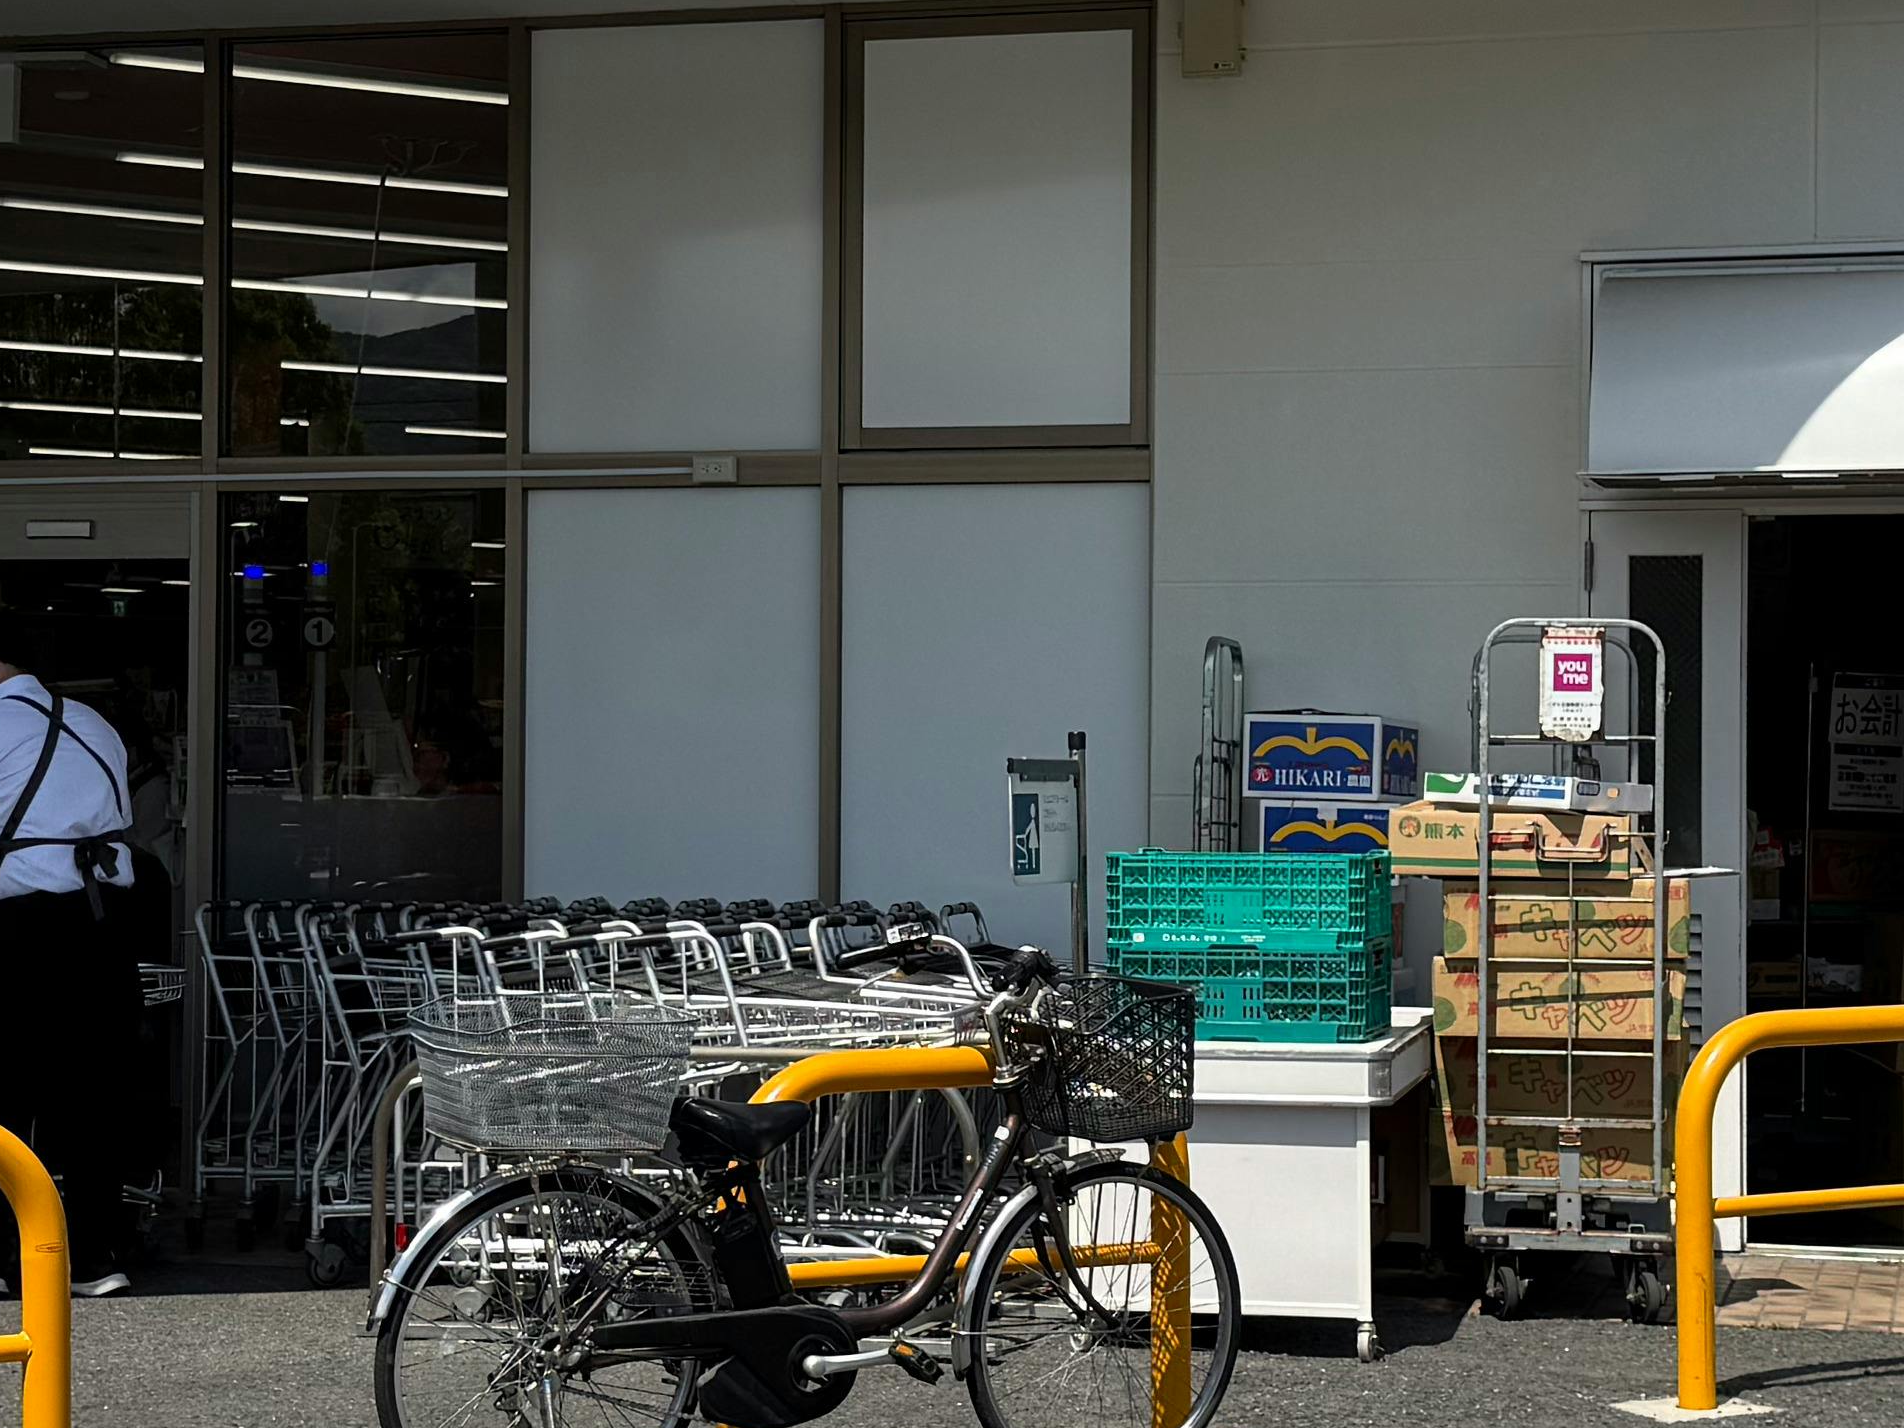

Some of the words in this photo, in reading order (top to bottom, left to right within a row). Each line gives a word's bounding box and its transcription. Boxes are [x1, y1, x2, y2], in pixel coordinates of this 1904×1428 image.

[1557, 660, 1587, 674] you
[1563, 673, 1588, 684] me
[1835, 693, 1902, 737] お会計
[1274, 769, 1341, 786] HIKARI
[1425, 823, 1465, 839] 熊本
[1520, 904, 1648, 952] キャベツ
[1510, 982, 1639, 1031] キャベツ
[1508, 1058, 1636, 1105] キャベツ
